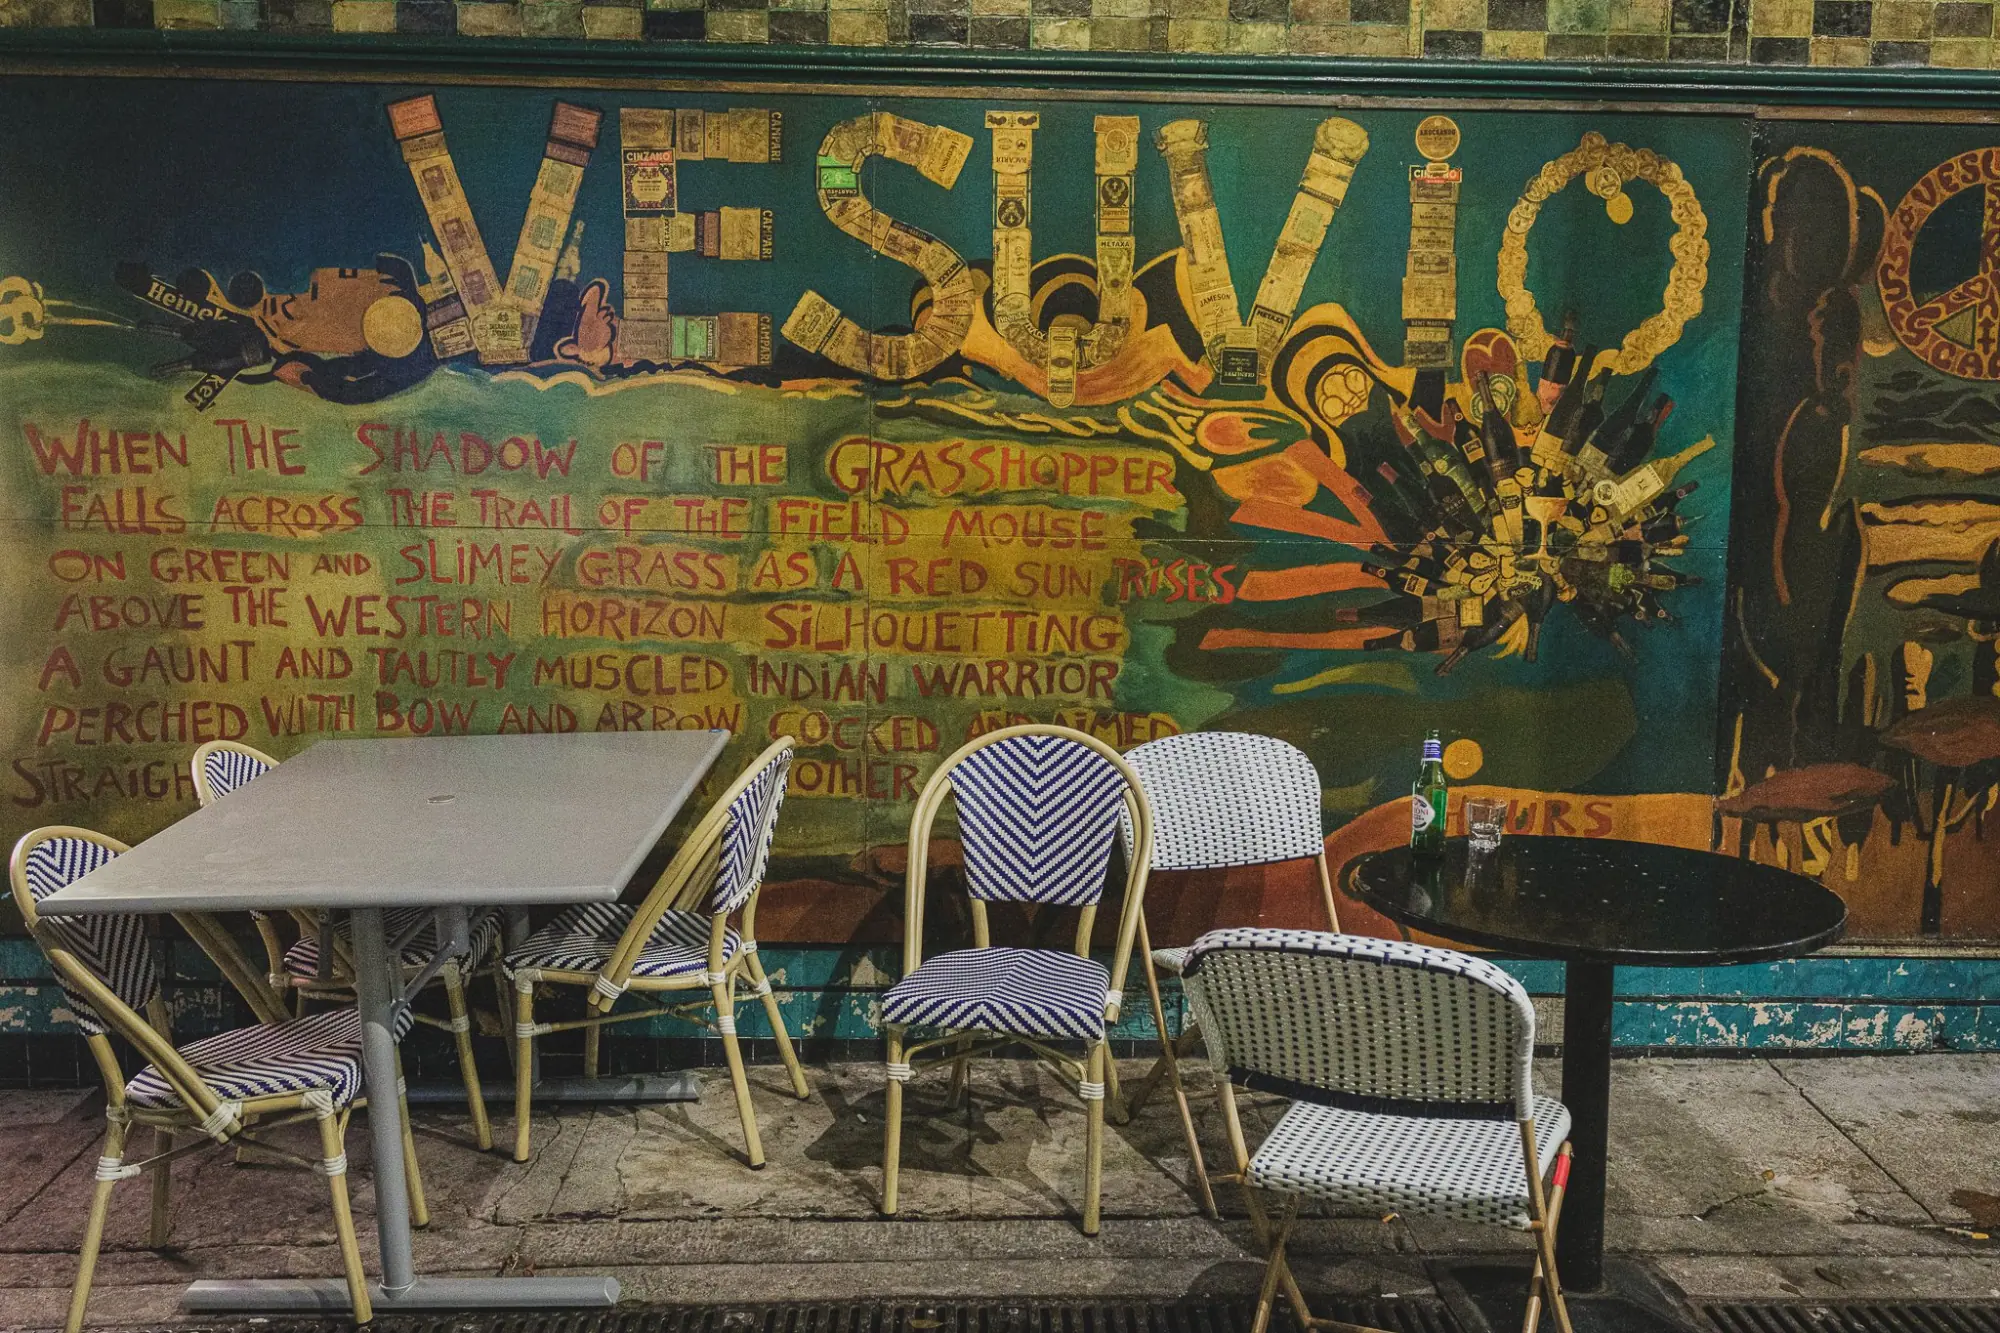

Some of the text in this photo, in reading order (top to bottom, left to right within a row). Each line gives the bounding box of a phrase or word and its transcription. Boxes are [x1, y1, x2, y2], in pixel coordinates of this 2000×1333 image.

[626, 151, 670, 161] CINZANO
[770, 111, 782, 161] CAMPARI
[762, 210, 773, 259] CAMPARI
[1200, 294, 1231, 307] JAMESON
[1256, 309, 1285, 324] METAXA
[760, 315, 771, 364] CAMPARI
[23, 418, 1177, 497] WHEN THE SHADOW OF THE GRASSHOPPER
[60, 485, 188, 537] FALLS
[209, 494, 364, 538] ACROSS
[386, 487, 459, 528] THE
[469, 488, 582, 537] TRAIL
[598, 498, 650, 538] OF
[674, 497, 750, 541] THE
[941, 508, 1107, 550] MOUSE
[48, 549, 127, 584] ON
[150, 546, 290, 584] GREEN
[312, 553, 372, 577] AND
[578, 549, 728, 594] GRASS
[753, 551, 810, 591] AS
[831, 553, 865, 591] A
[889, 558, 988, 597] RED
[1008, 561, 1092, 599] SUN
[54, 593, 205, 632] ABOVE
[223, 586, 289, 629] THE
[305, 594, 512, 639] WESTERN
[543, 600, 726, 642] HORIZON
[37, 647, 82, 692] A
[104, 640, 256, 688] GAUNT
[276, 646, 353, 682] AND
[369, 646, 517, 690] TAUTLY
[533, 655, 729, 698] MUSCLED
[37, 700, 249, 748] PERCHED
[260, 694, 357, 738] WITH
[375, 699, 480, 734] BOW
[498, 702, 578, 734] AND
[596, 701, 740, 735] ARROW
[768, 710, 940, 754] COCKED
